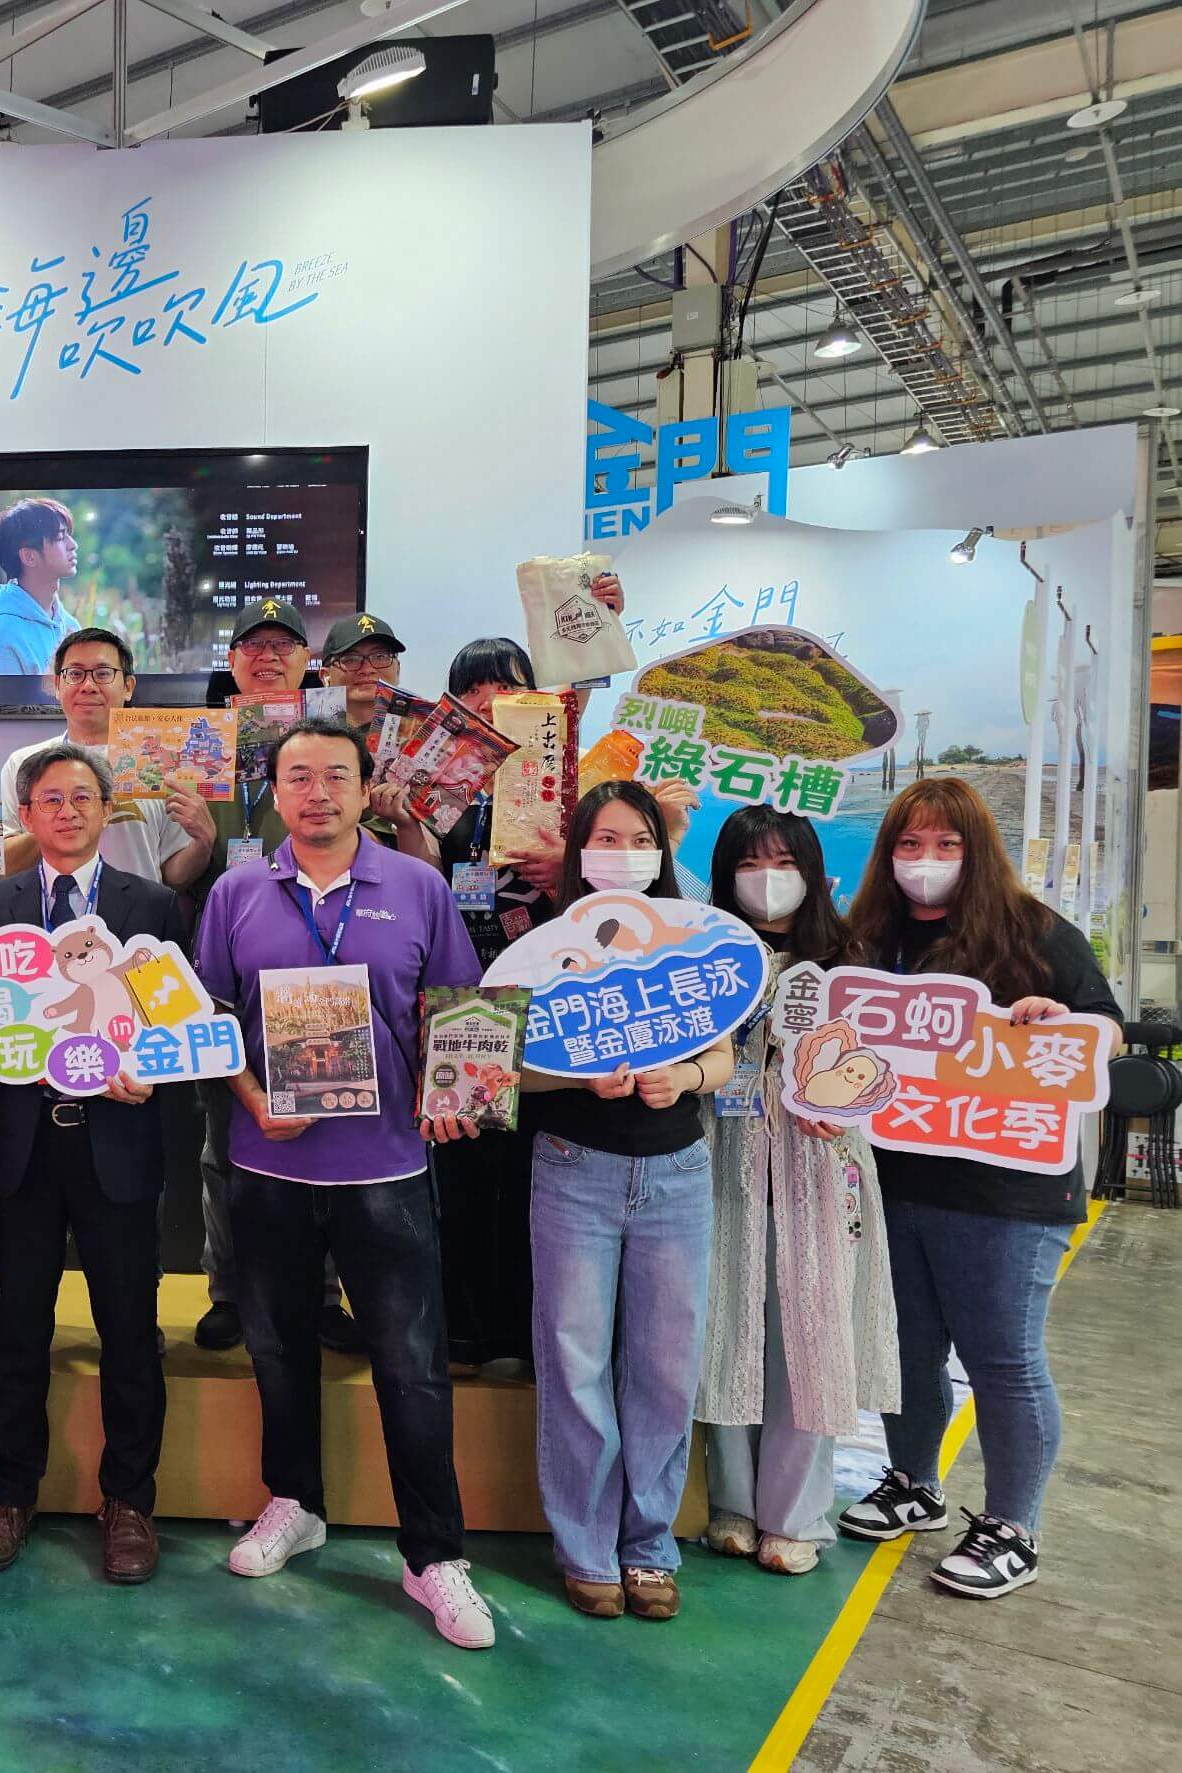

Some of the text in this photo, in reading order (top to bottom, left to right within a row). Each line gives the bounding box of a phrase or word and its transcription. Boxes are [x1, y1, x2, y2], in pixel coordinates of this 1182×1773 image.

[245, 513, 303, 522] Sound Department
[244, 580, 306, 590] Lighting Department
[619, 699, 704, 739] 烈嶼
[640, 735, 845, 817] 綠石槽
[112, 1018, 132, 1037] in
[525, 957, 750, 1044] 金門海上長泳
[781, 969, 820, 1035] 金寧
[840, 986, 968, 1046] 石蚵
[63, 1043, 105, 1084] 樂
[132, 1019, 241, 1078] 金門
[433, 1039, 510, 1053] 戰地牛肉乾
[563, 1004, 719, 1068] 暨金廈泳渡
[955, 1026, 1088, 1089] 小麥
[889, 1085, 1062, 1150] 文化季
